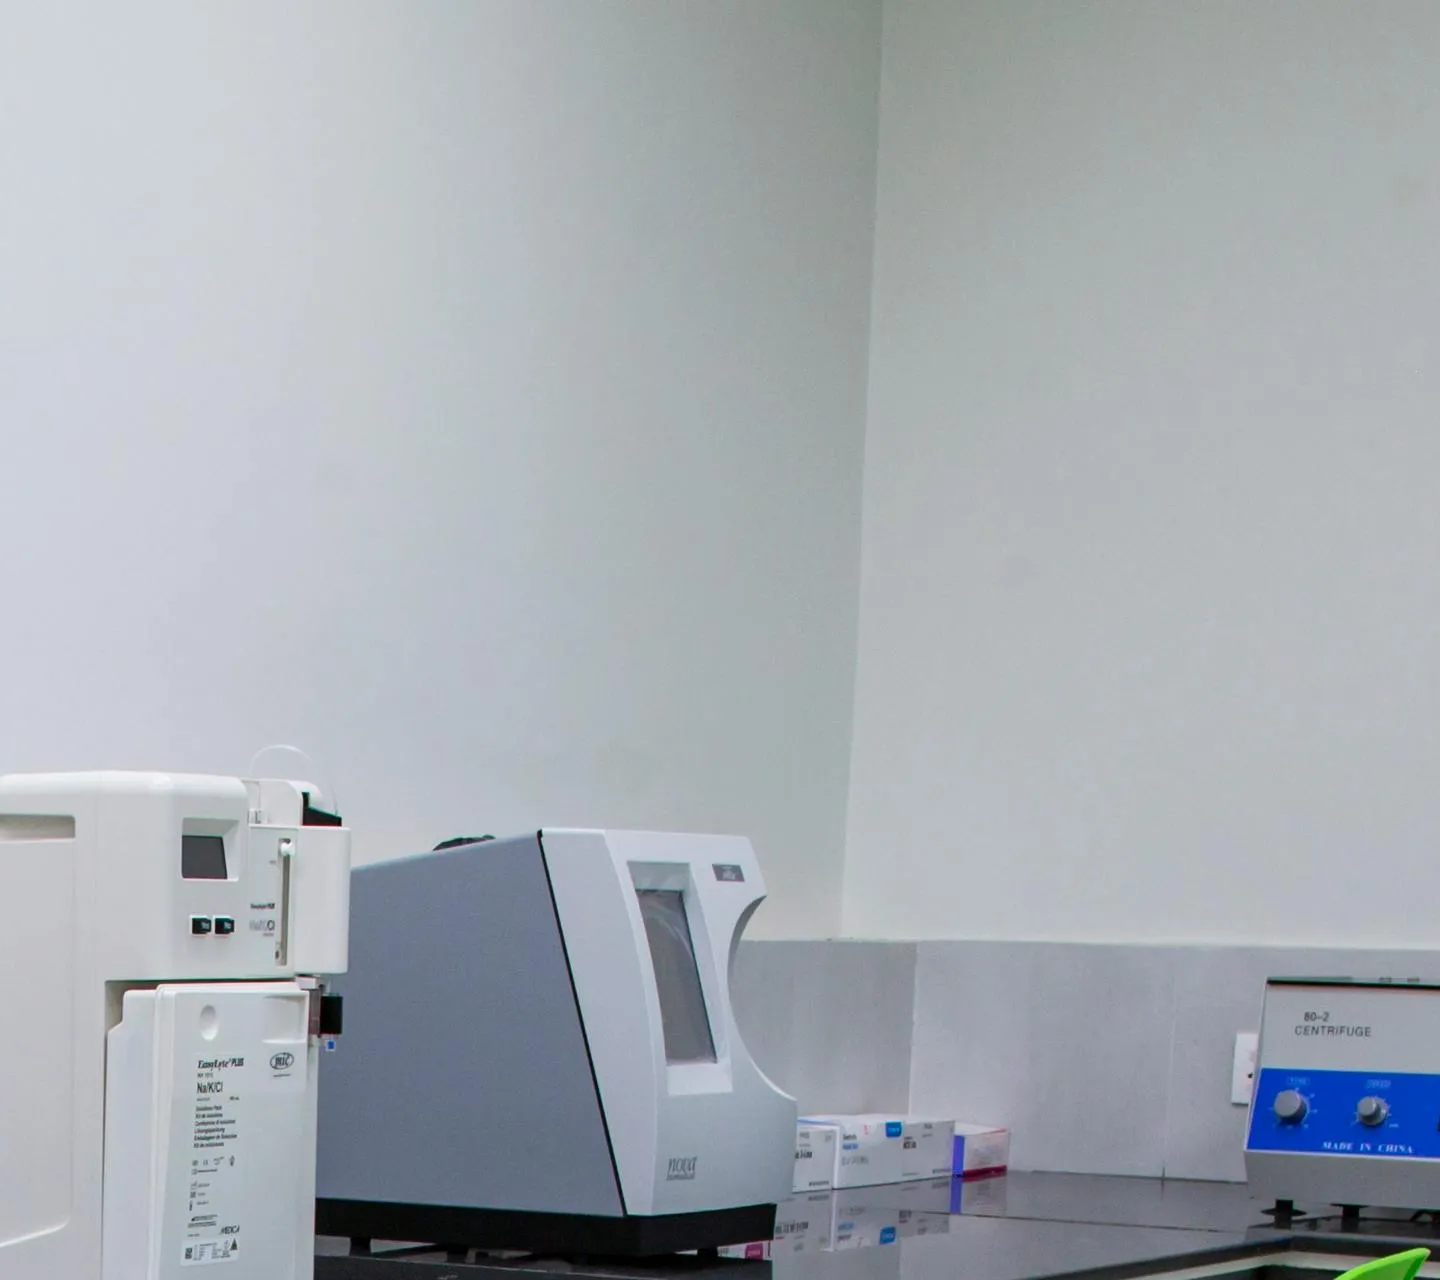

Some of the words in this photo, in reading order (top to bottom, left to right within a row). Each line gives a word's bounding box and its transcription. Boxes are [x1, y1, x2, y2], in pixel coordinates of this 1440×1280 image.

[1303, 1011, 1330, 1022] 80-2
[1294, 1025, 1372, 1037] CENTRIFUGE
[1322, 1141, 1354, 1151] MADE
[1360, 1142, 1372, 1152] IN
[1377, 1143, 1414, 1154] CHINA
